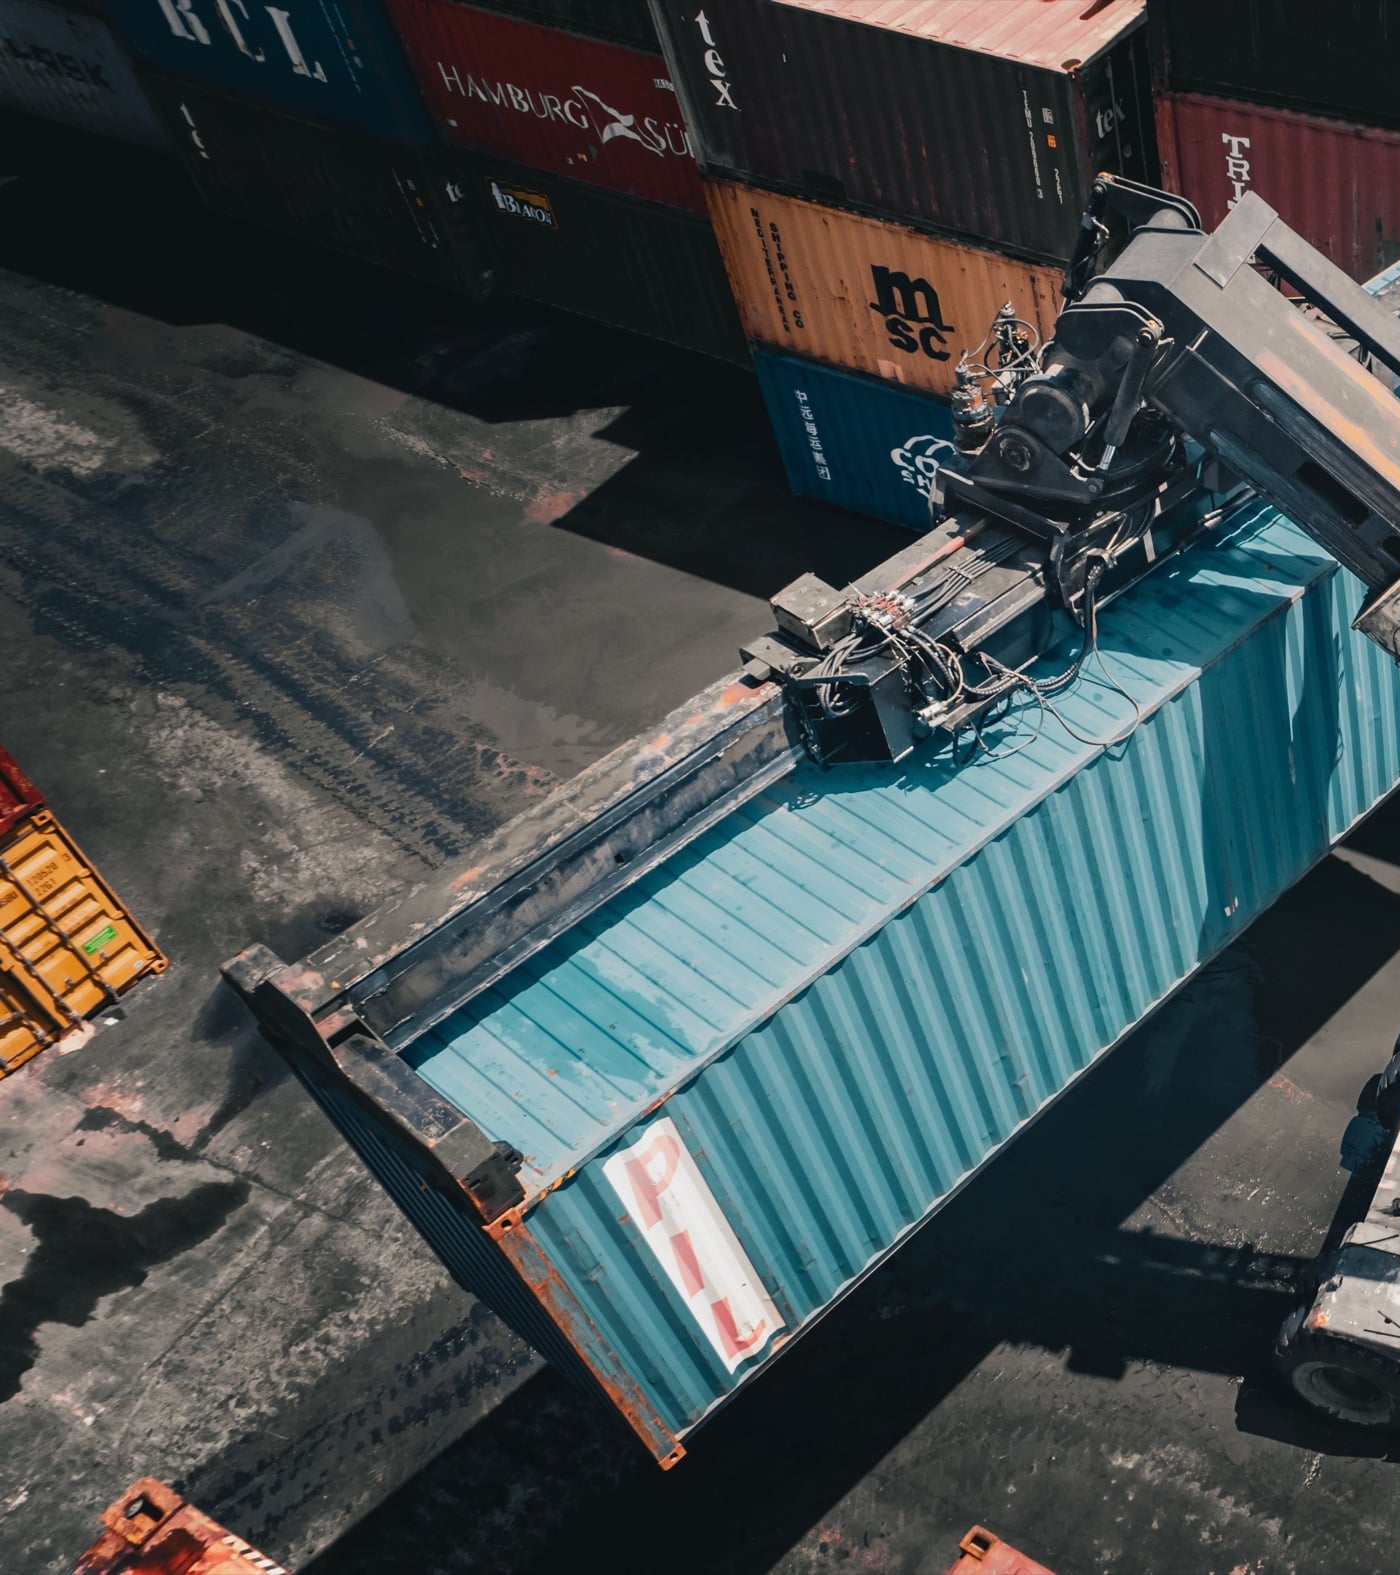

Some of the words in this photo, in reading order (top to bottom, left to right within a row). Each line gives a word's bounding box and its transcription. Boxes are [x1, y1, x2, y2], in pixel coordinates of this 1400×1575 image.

[437, 61, 590, 129] HAMBURG
[643, 117, 696, 159] SÜ
[1221, 131, 1252, 211] TRI
[769, 222, 797, 301] SHIPPING
[793, 310, 804, 329] CO
